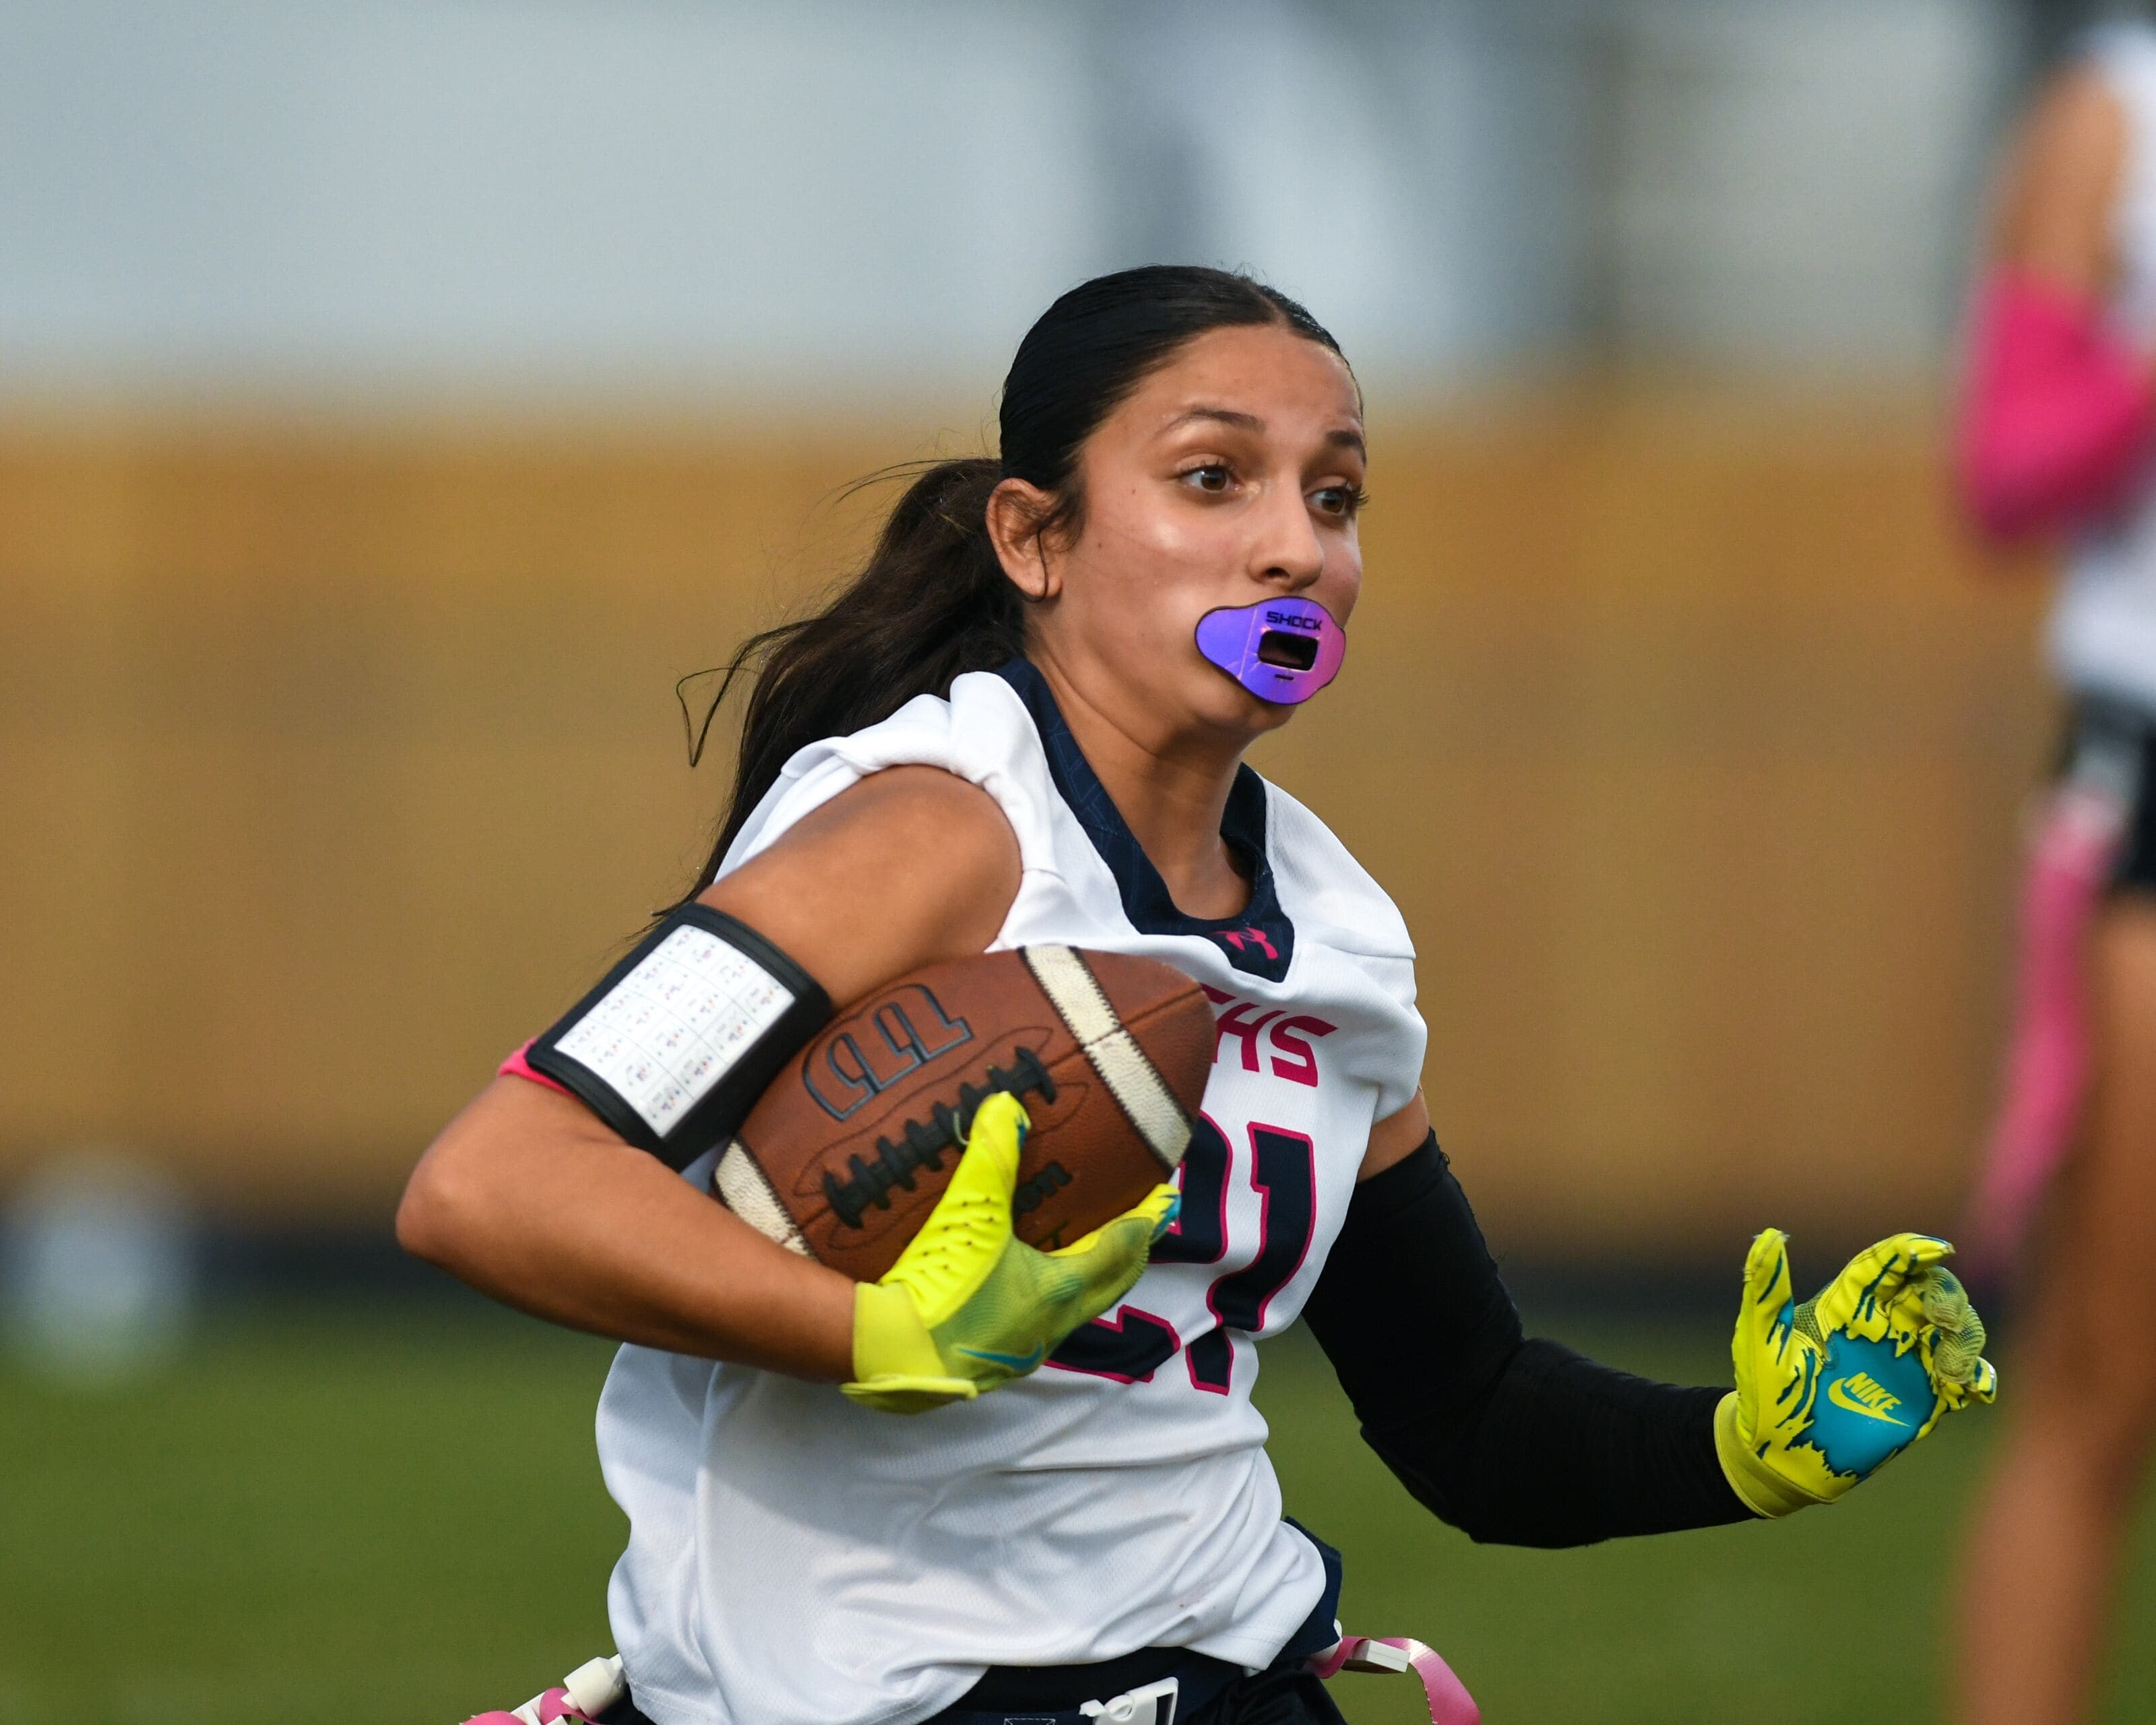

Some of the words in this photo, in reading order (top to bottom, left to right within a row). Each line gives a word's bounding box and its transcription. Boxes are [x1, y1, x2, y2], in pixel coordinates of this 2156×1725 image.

[1267, 611, 1323, 631] SHOCK
[1200, 982, 1339, 1088] HS
[1845, 1372, 1903, 1412] NIKE
